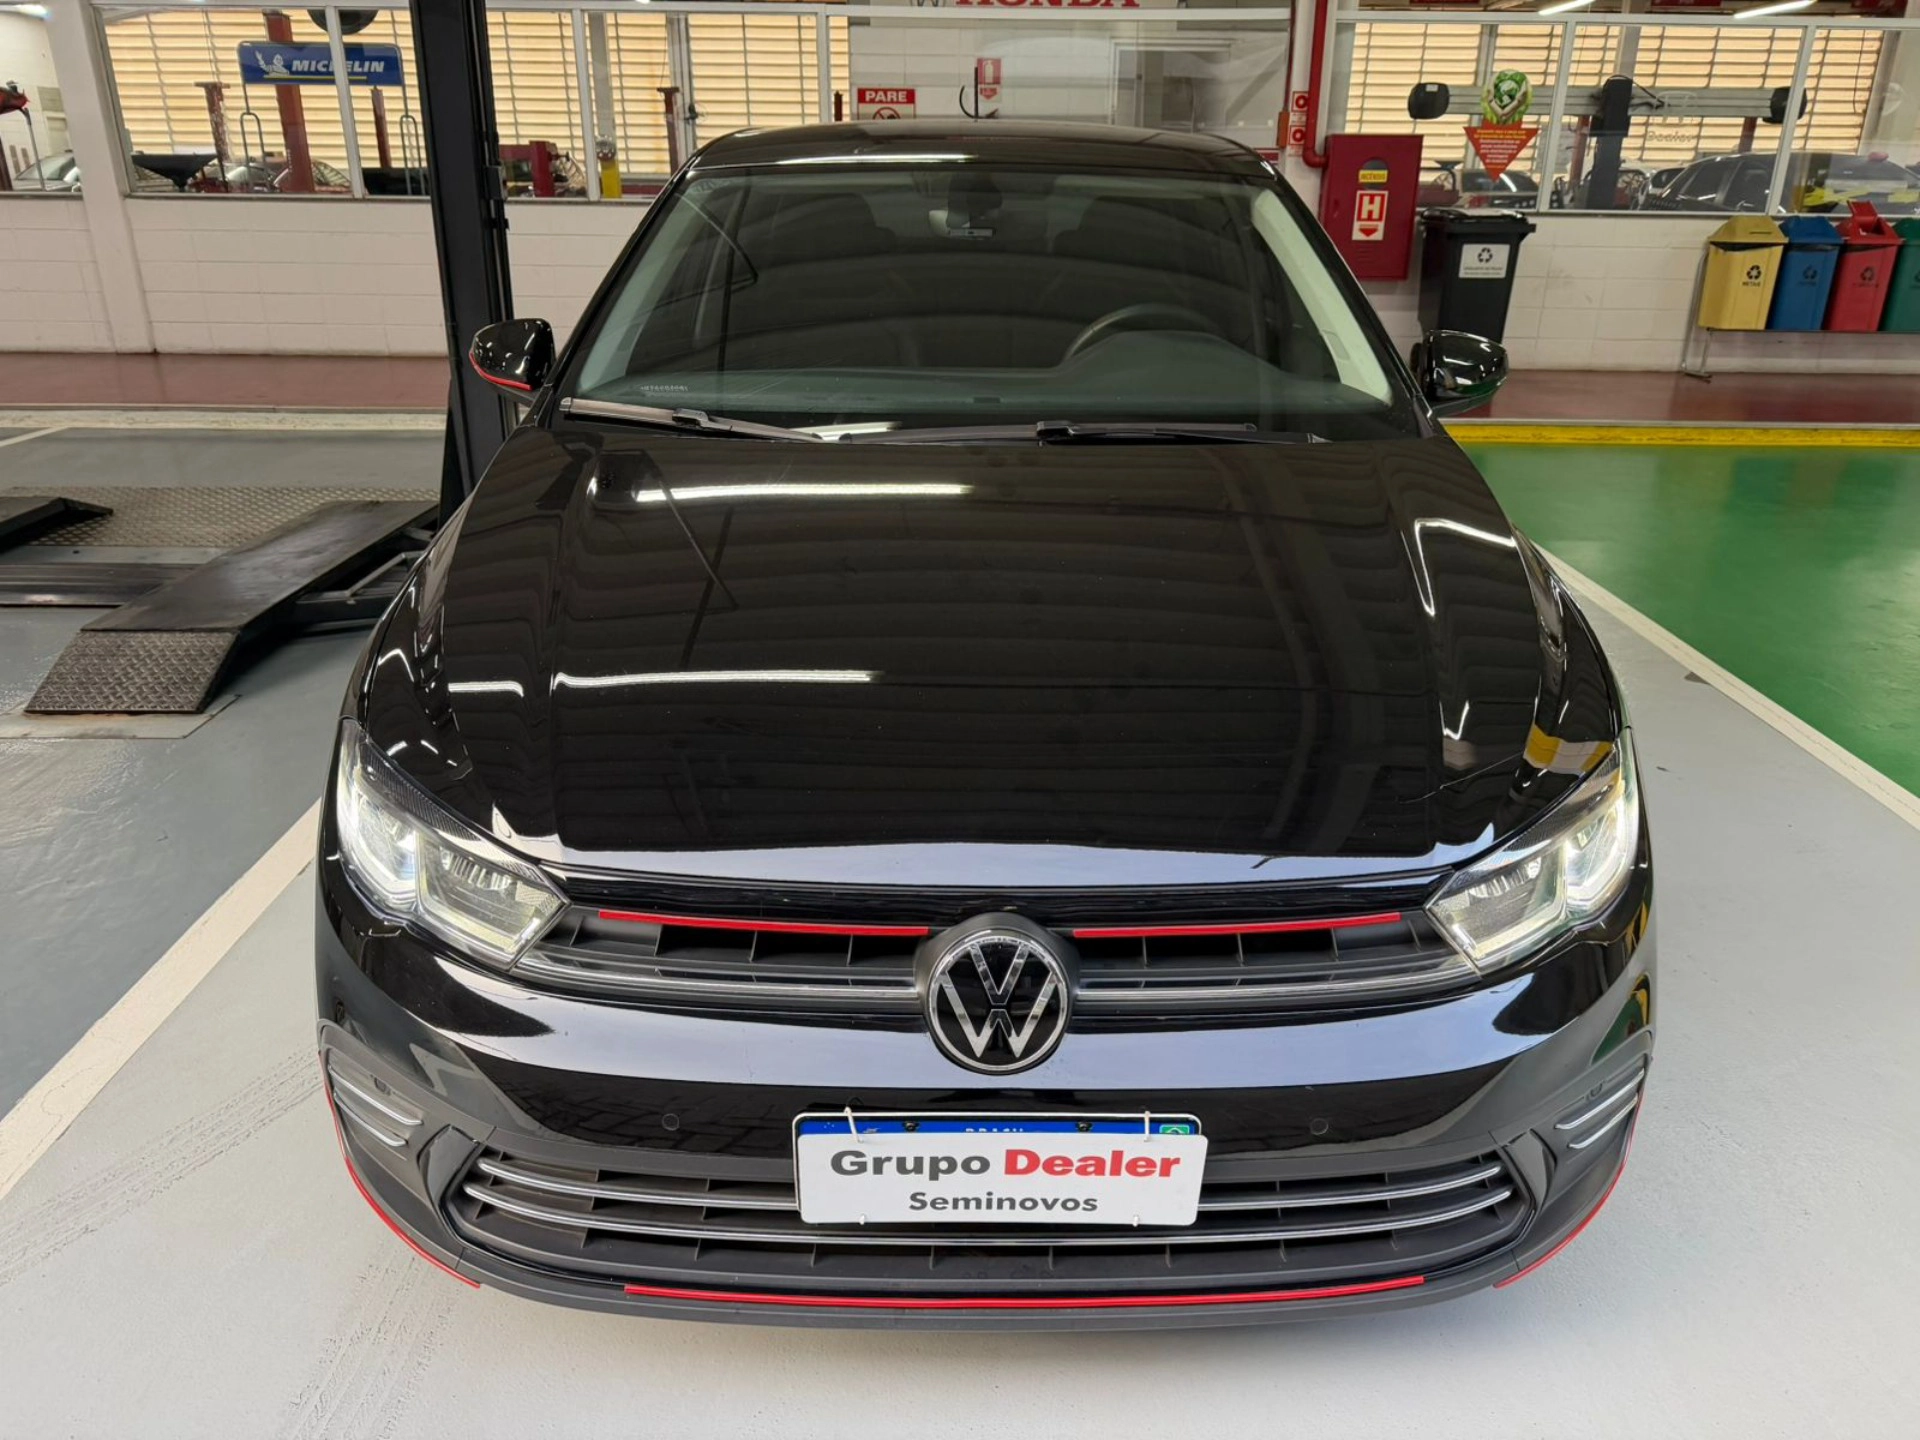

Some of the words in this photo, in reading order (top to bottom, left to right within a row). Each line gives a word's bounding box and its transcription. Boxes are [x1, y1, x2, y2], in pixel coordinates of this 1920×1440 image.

[292, 60, 385, 73] MICELIN
[865, 90, 908, 102] PARE
[1360, 195, 1382, 220] H
[830, 1150, 991, 1182] Grupo
[1003, 1148, 1182, 1178] Dealer
[908, 1191, 1099, 1212] Seminovos
